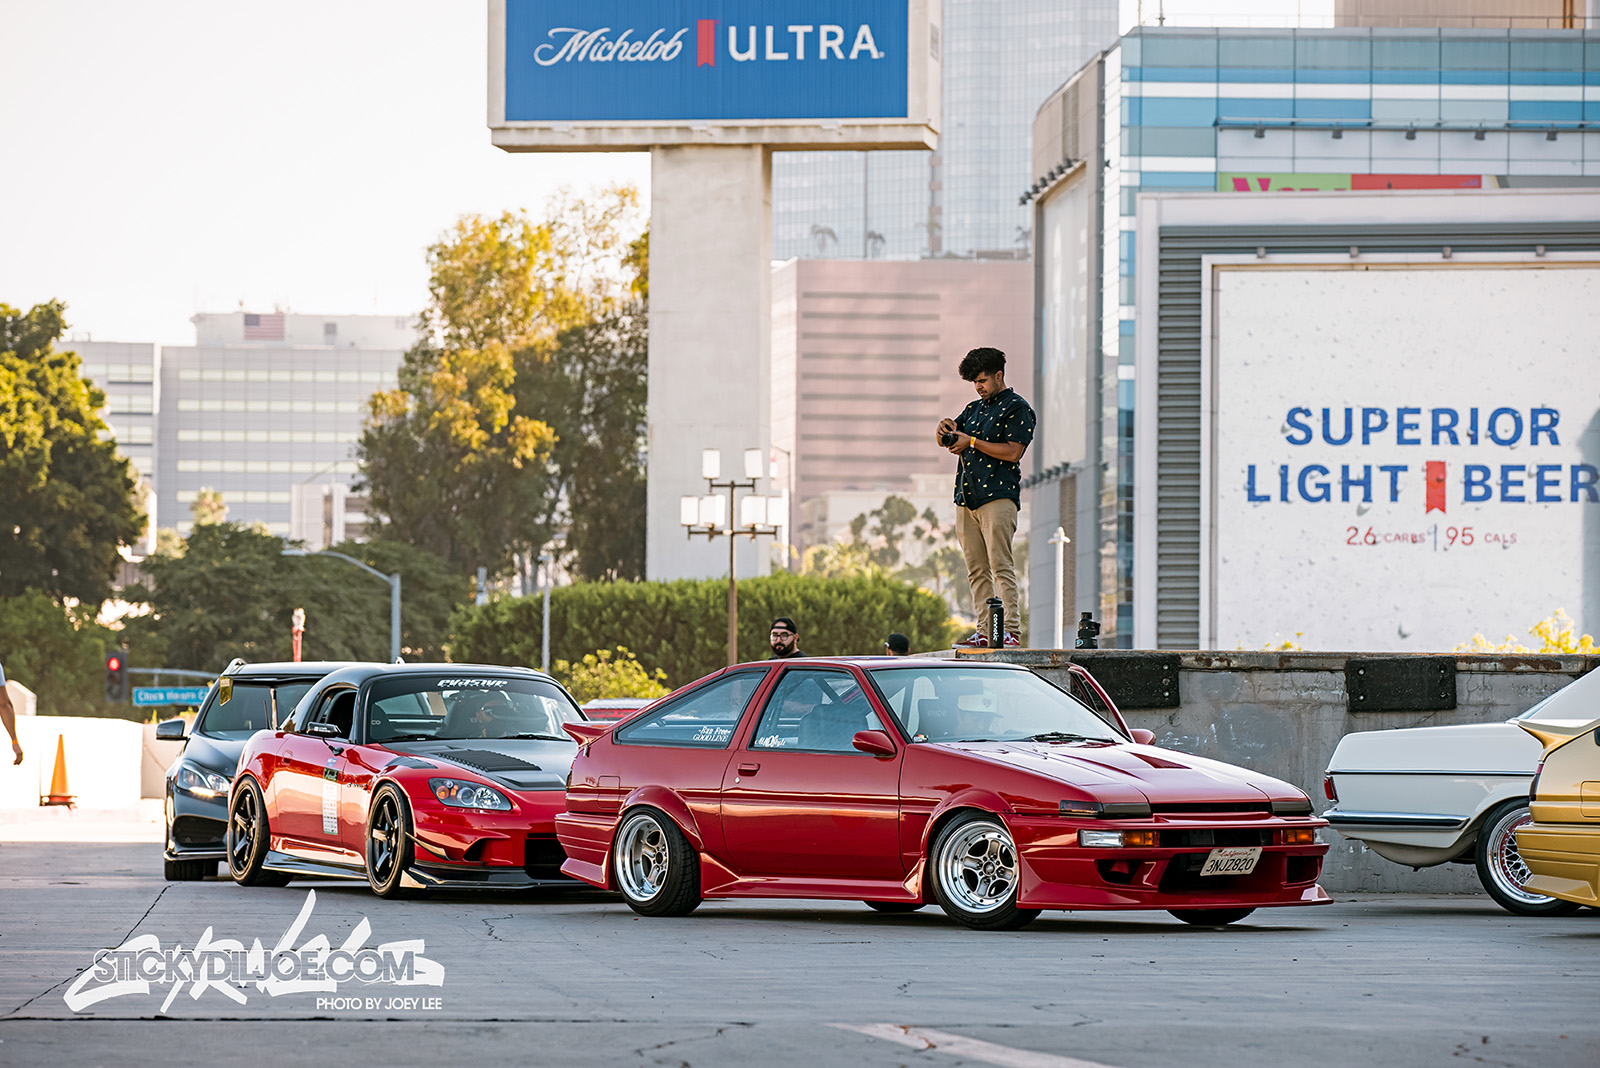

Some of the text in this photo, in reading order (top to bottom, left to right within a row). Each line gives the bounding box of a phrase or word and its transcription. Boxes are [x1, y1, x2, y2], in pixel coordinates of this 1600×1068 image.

[534, 24, 882, 67] Michelob ULTRA
[1284, 406, 1561, 447] SUPERIOR
[1247, 464, 1600, 503] LIGHT BEER
[1346, 526, 1517, 546] 2.6 CARBS 95 CALS
[1206, 858, 1254, 873] 3NJZ820
